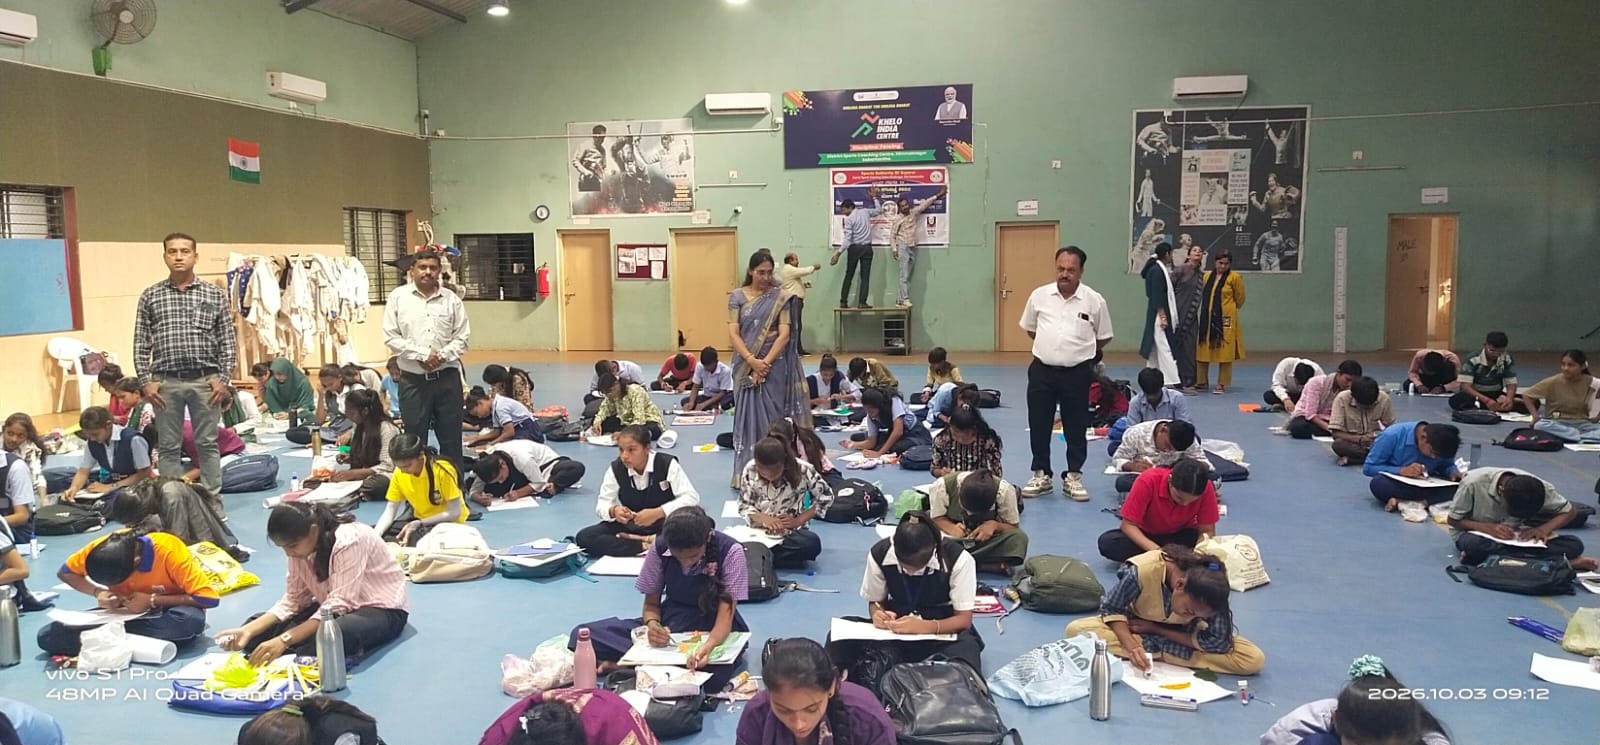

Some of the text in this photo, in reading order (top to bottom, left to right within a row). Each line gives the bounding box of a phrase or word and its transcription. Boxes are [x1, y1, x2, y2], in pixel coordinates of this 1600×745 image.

[878, 117, 903, 126] KHELO
[876, 124, 898, 133] INDIA
[876, 132, 900, 140] CENTRE
